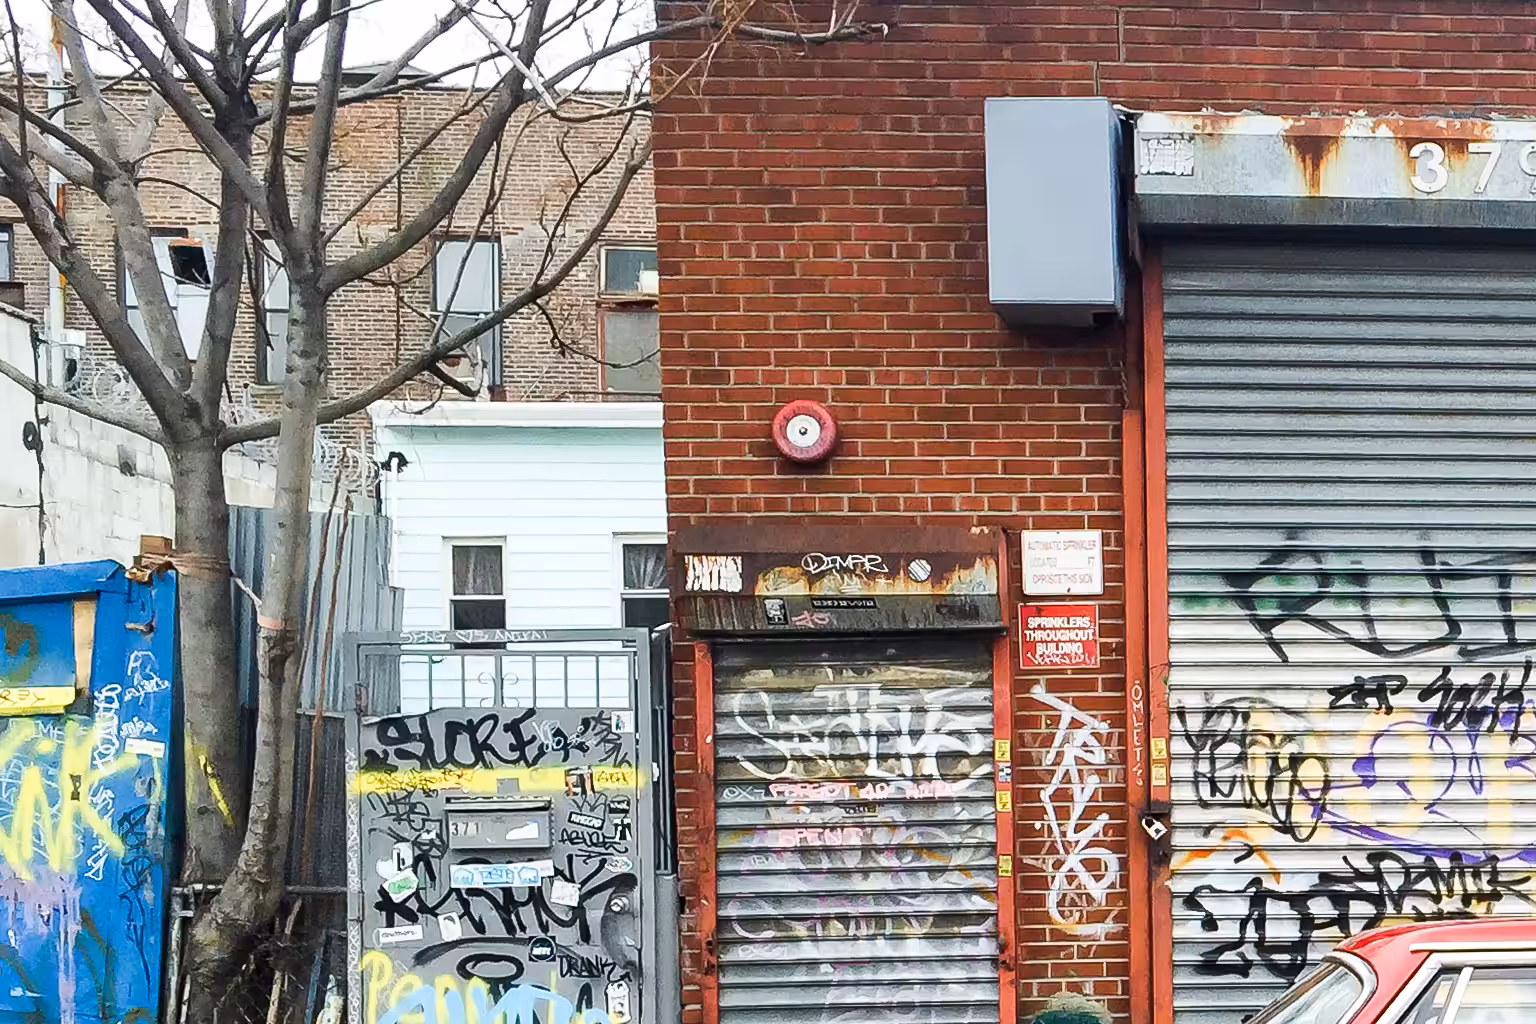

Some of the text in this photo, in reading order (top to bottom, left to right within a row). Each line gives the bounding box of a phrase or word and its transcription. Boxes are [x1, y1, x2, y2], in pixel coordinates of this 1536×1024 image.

[1027, 616, 1091, 628] SPRINKLERS
[1024, 629, 1095, 641] THROUGHOUT
[1036, 642, 1083, 655] BUILDING
[451, 821, 480, 837] 371
